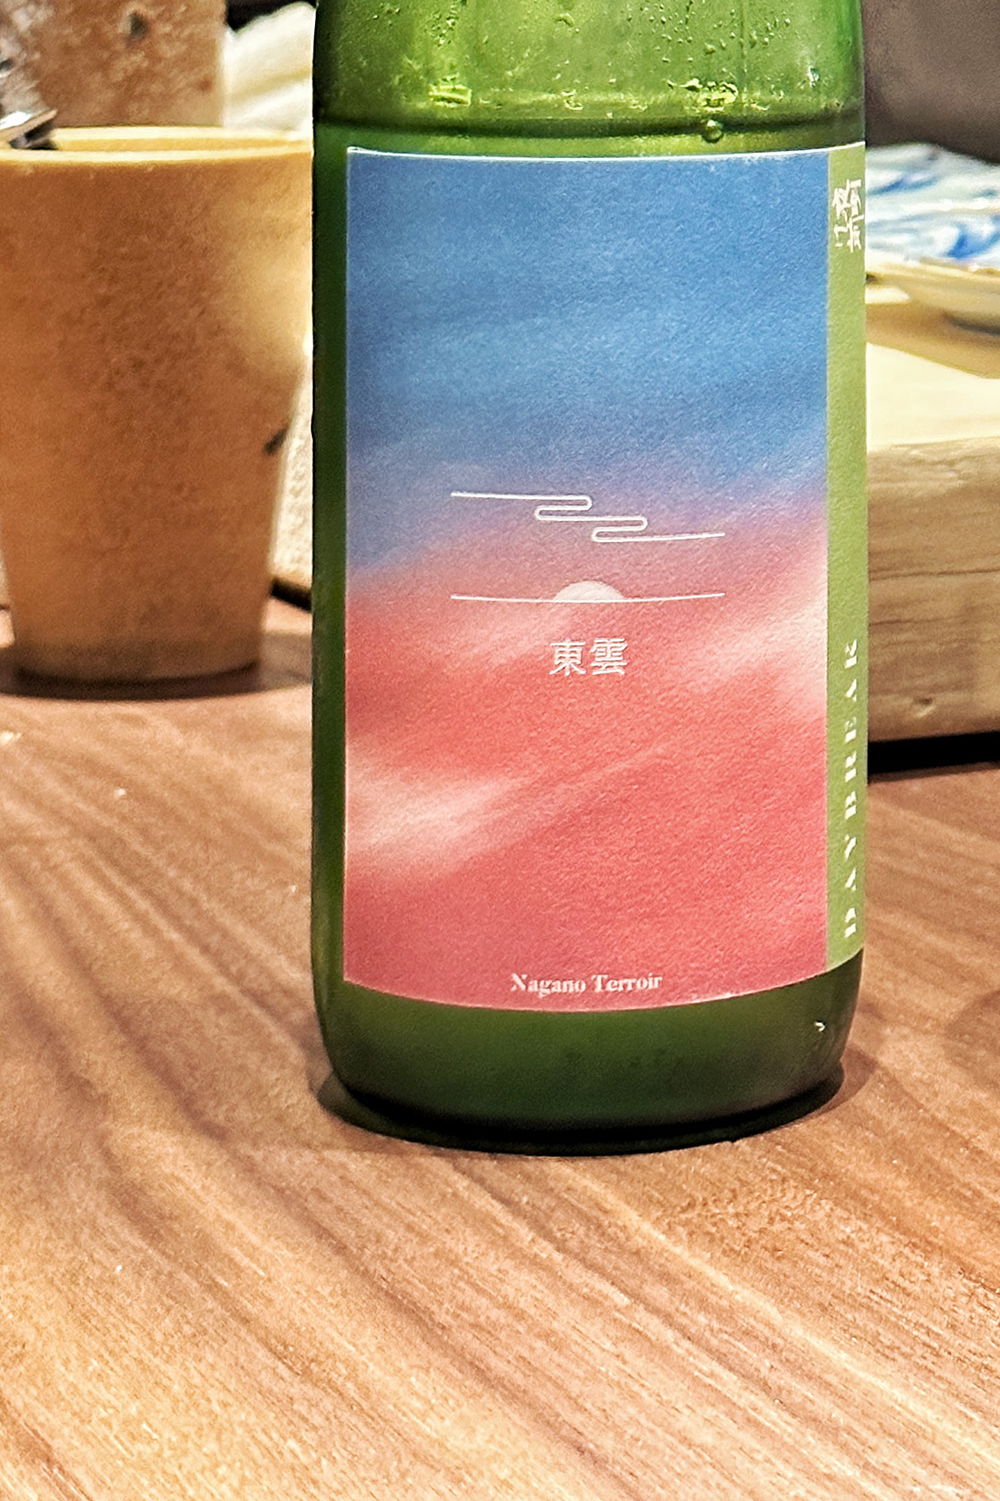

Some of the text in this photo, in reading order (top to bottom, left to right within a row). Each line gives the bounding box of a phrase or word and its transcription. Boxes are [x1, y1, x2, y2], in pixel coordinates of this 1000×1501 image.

[549, 637, 629, 676] 東雲
[844, 638, 858, 939] DAYBREAK
[510, 972, 663, 999] Nagano Terroir
